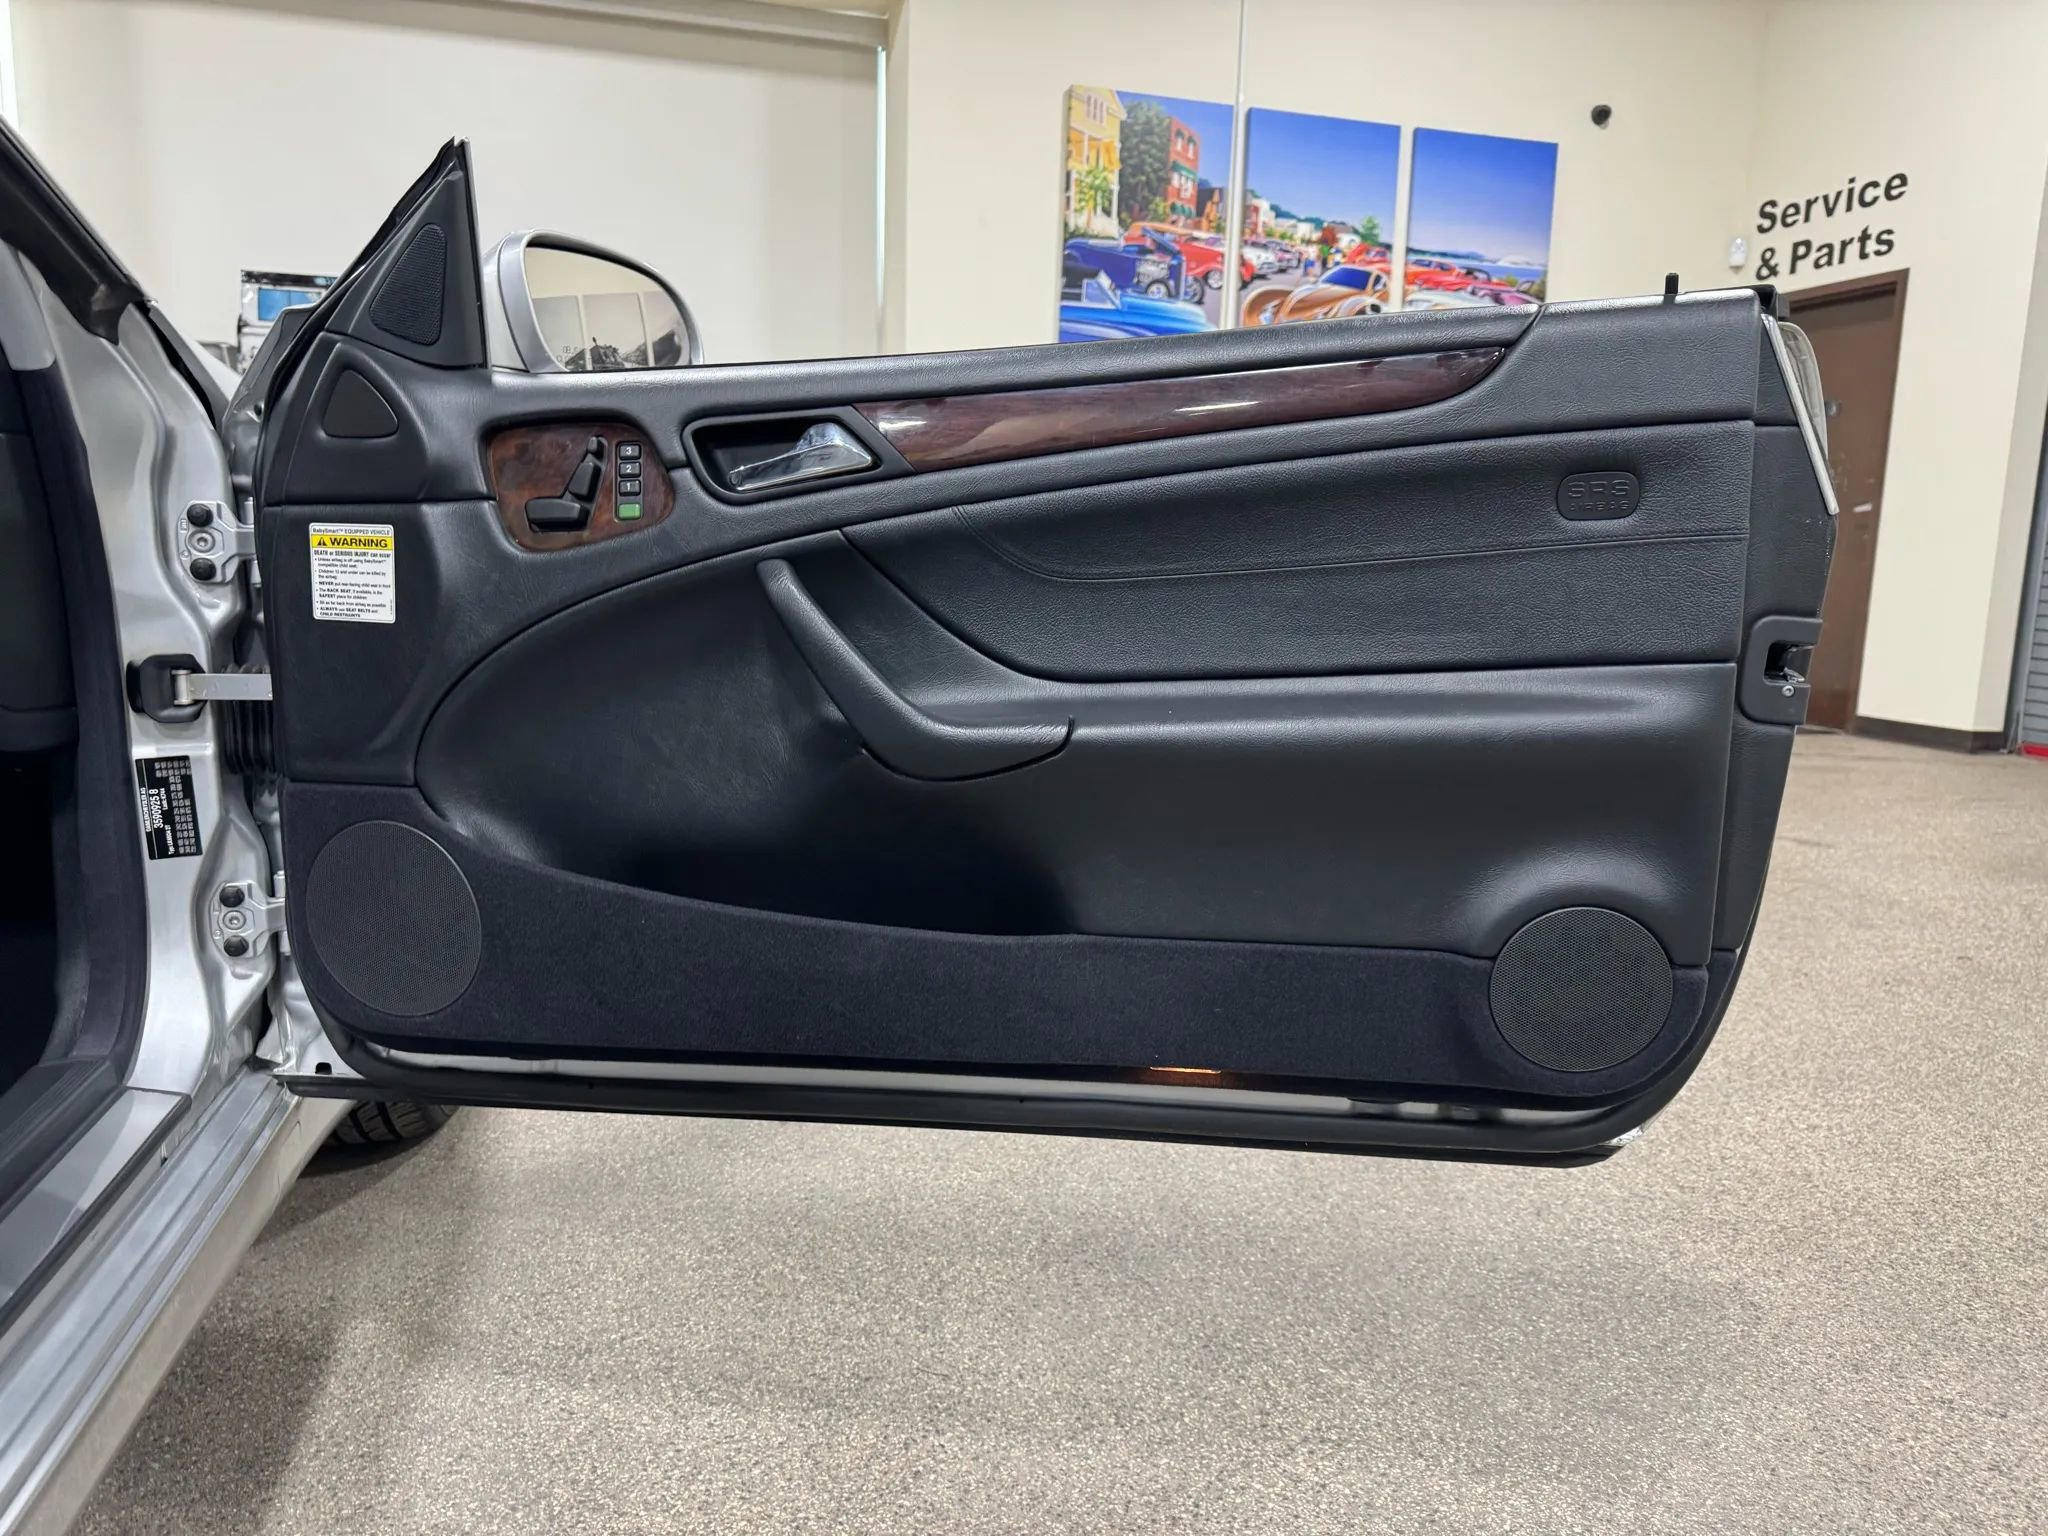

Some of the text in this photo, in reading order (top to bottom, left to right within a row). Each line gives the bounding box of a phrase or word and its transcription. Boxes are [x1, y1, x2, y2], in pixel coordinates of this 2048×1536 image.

[1756, 172, 1908, 234] Service
[1755, 225, 1895, 281] & Parts
[625, 446, 632, 455] 3
[625, 464, 632, 473] 2
[330, 537, 388, 548] WARNING
[149, 796, 164, 829] 3590925
